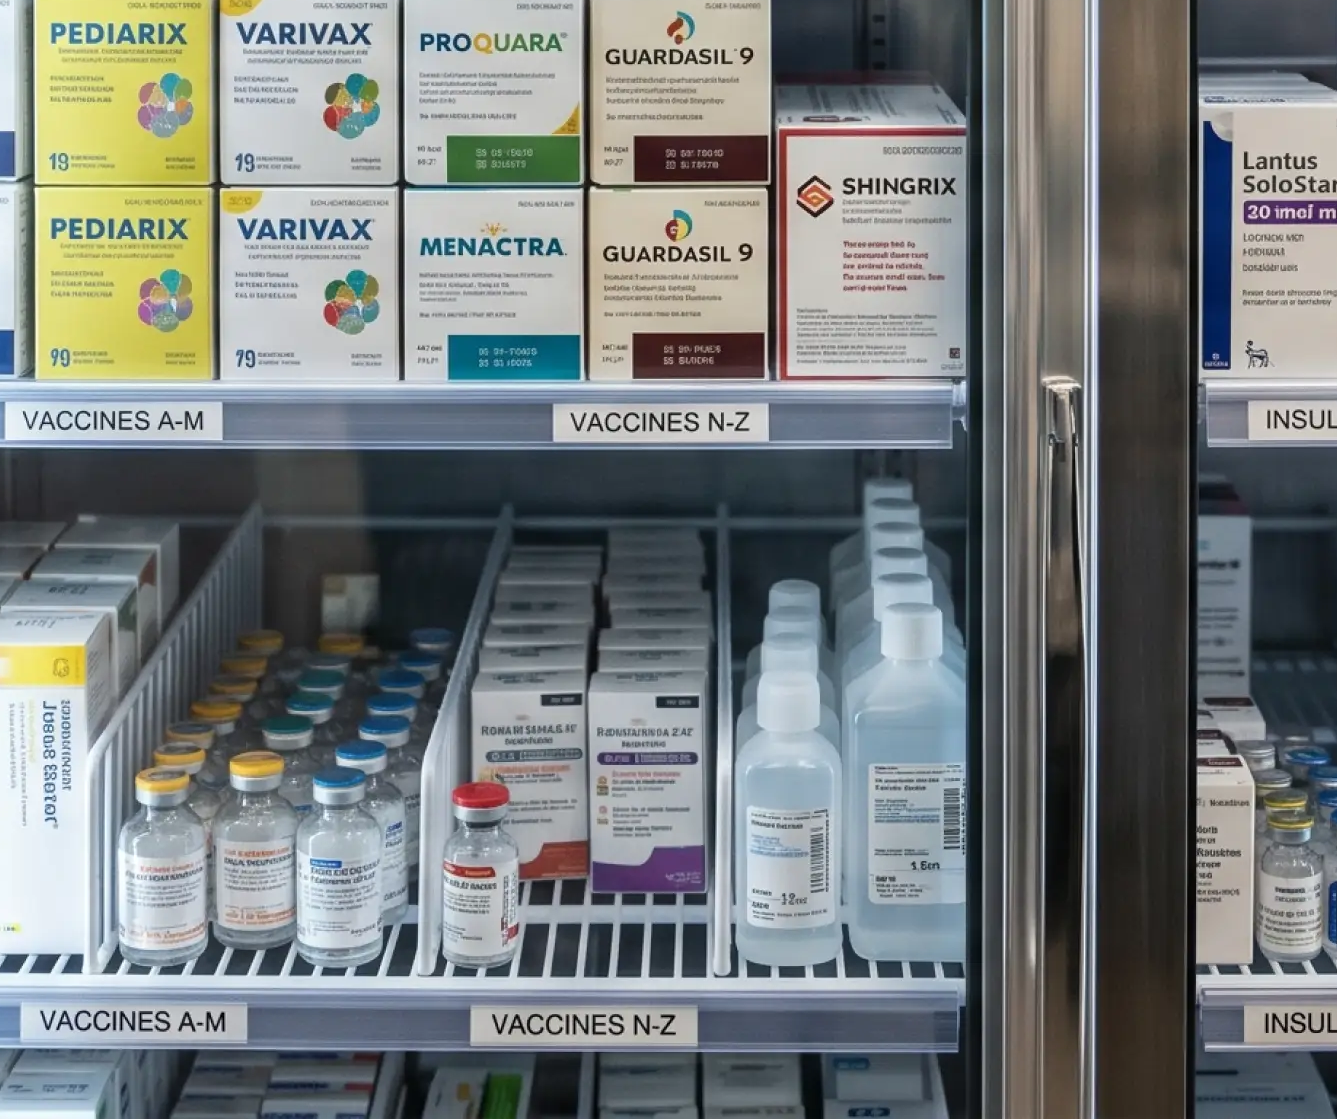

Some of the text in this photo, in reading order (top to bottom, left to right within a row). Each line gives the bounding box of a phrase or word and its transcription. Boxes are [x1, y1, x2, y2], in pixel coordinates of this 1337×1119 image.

[50, 22, 188, 45] PEDIARIX
[236, 22, 372, 45] VARIVAX
[420, 32, 563, 55] PROQUARA
[605, 46, 754, 66] GUARDASIL 9
[1243, 151, 1318, 170] Lantus
[841, 177, 957, 195] SHINGRIX
[50, 217, 189, 240] PEDIARIX
[237, 217, 373, 241] VARIVAX
[419, 237, 563, 256] MENACTRA
[602, 242, 754, 263] GUARDASIL 9
[22, 410, 204, 431] VACCINES A-M
[570, 411, 750, 432] VACCINES N-Z
[40, 1010, 226, 1032] VACCINES A-M
[492, 1013, 677, 1035] VACCINES N-Z
